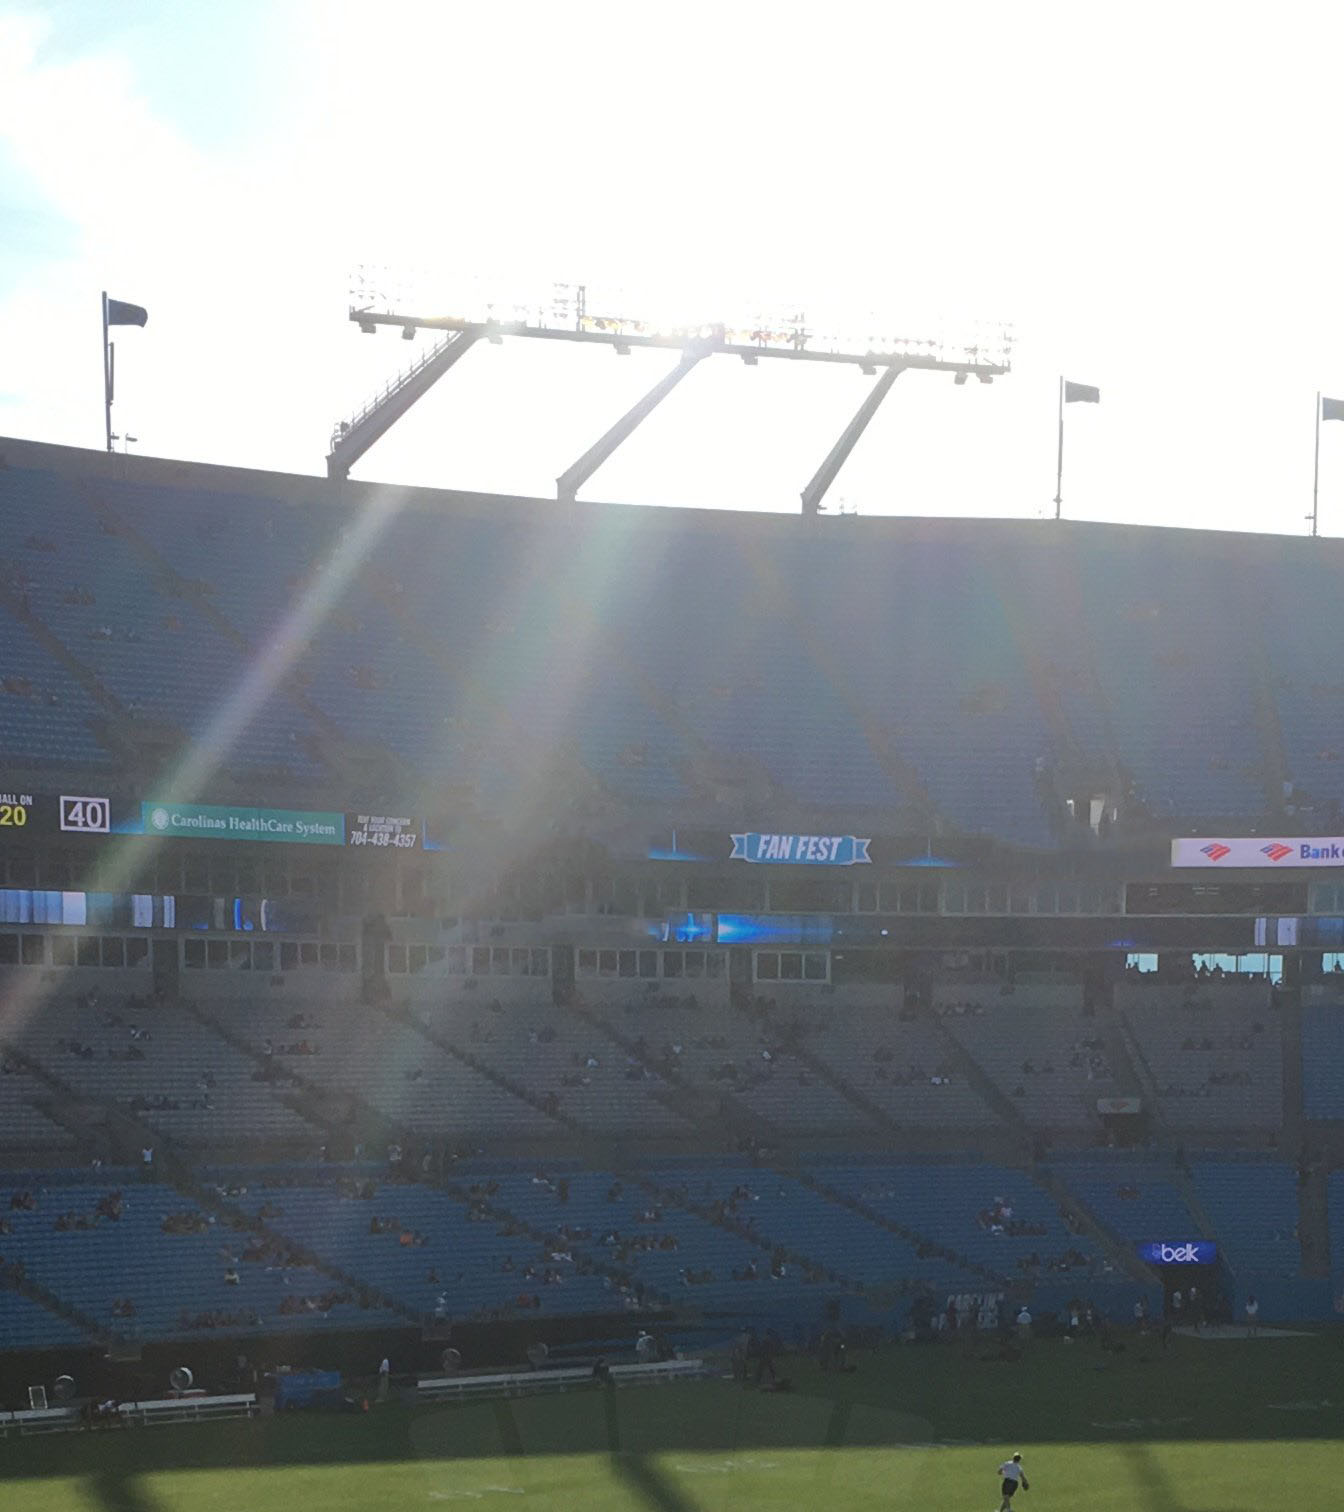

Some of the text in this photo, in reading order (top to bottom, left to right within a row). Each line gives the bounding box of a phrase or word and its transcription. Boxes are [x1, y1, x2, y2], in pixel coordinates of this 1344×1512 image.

[20, 794, 33, 806] ON
[0, 805, 26, 826] 20
[67, 801, 103, 828] 40
[171, 814, 336, 837] Carolinas HealthCare System
[756, 834, 843, 861] FAN FEST
[1300, 843, 1341, 860] Bank
[1161, 1243, 1199, 1262] belk
